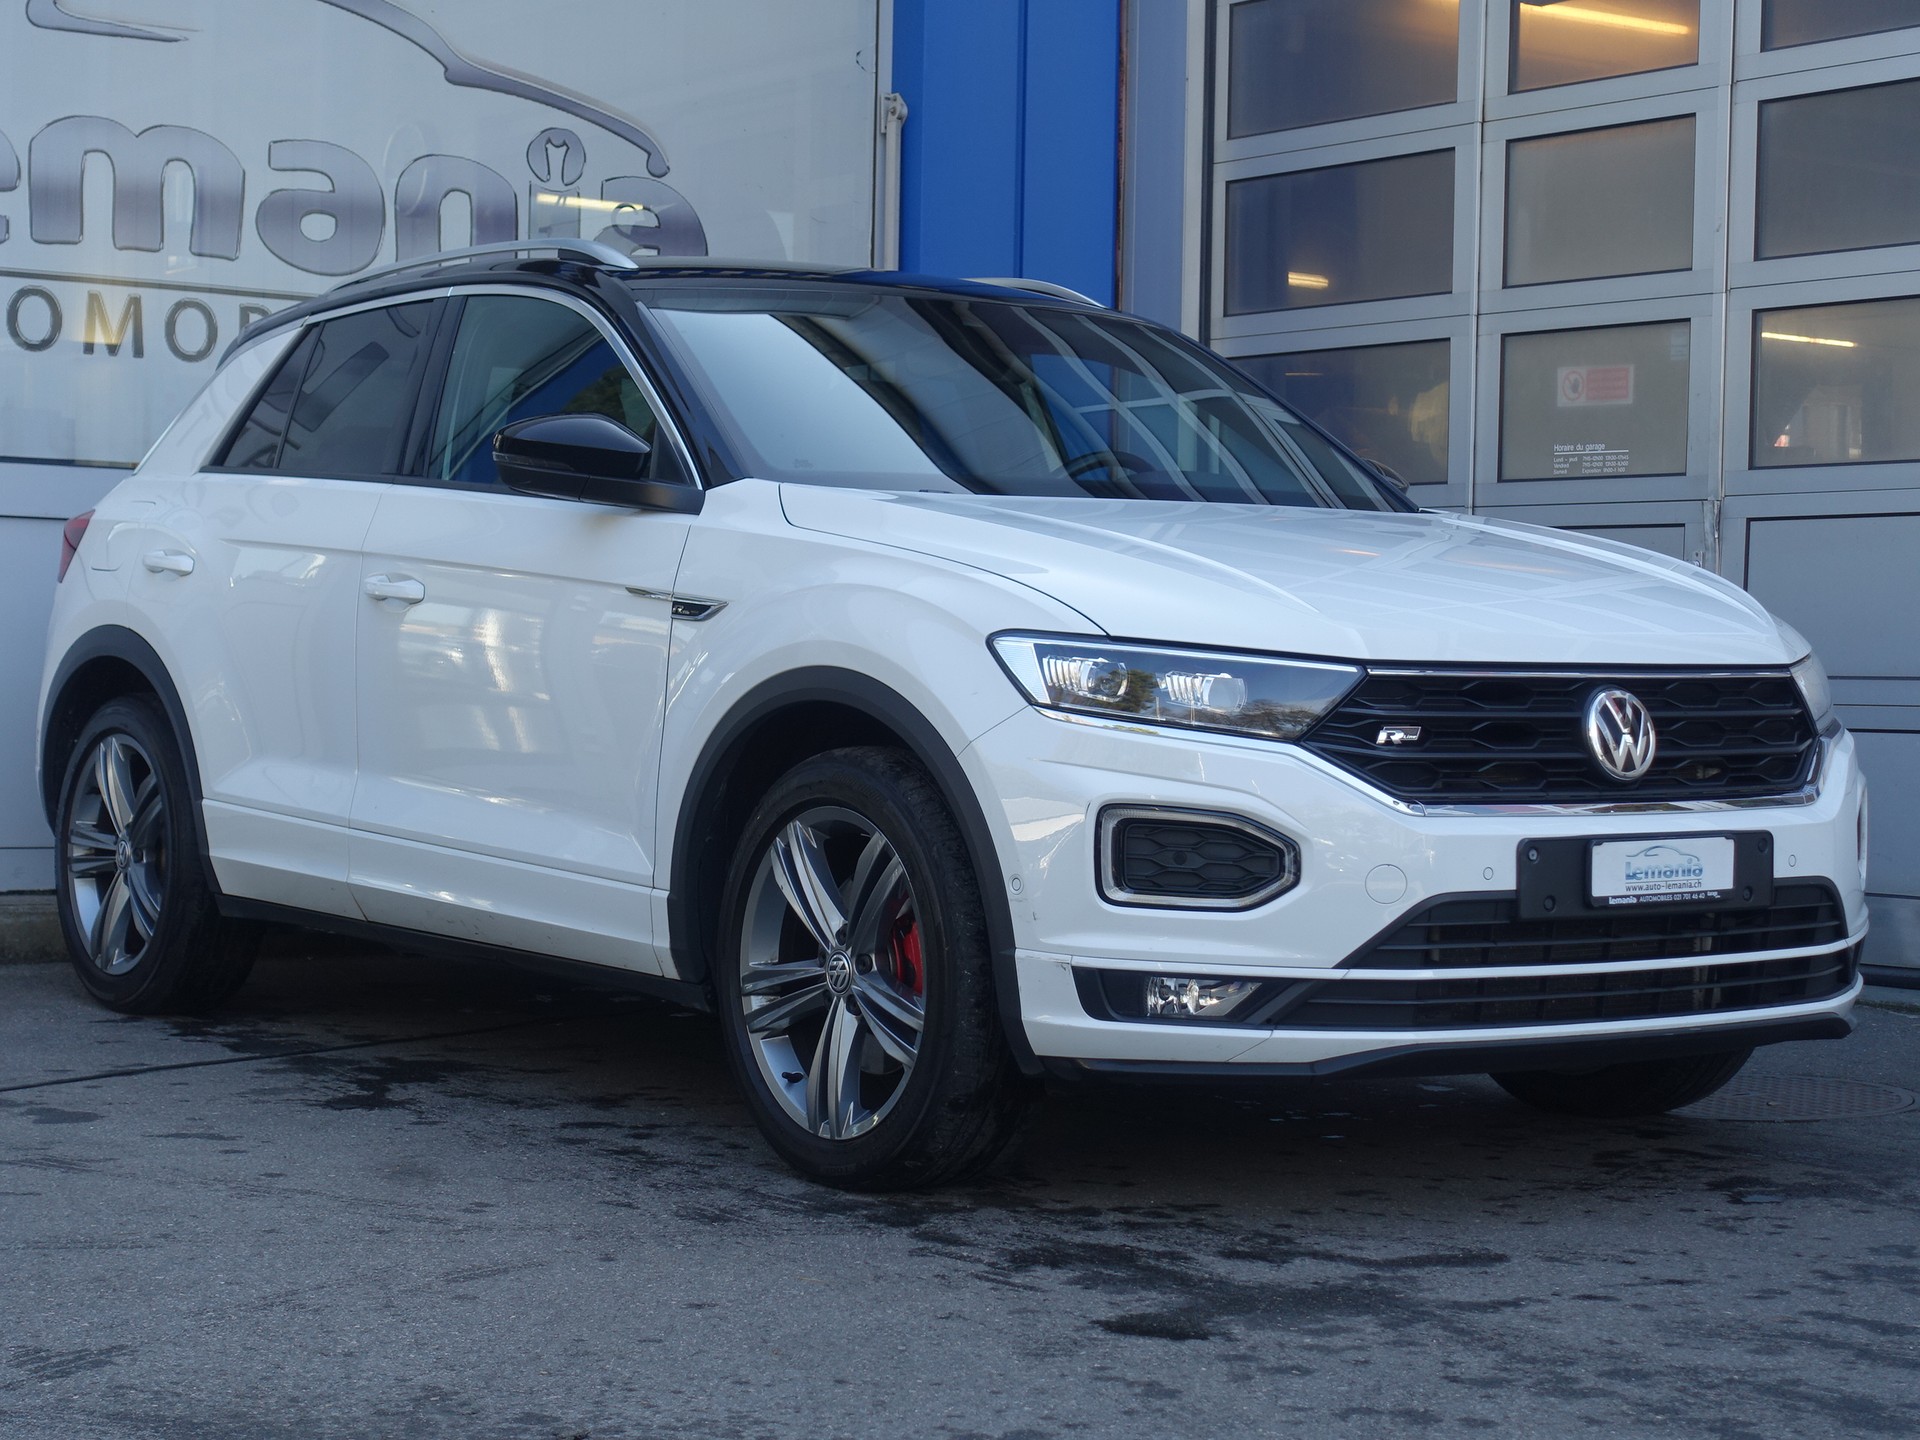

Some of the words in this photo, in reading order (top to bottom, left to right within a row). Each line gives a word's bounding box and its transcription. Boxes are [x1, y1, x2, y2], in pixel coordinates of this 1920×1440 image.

[0, 114, 708, 276] mania
[1553, 444, 1574, 452] Horaire
[1575, 443, 1584, 451] du
[1585, 443, 1606, 453] garage
[1625, 858, 1703, 881] Lemania
[1625, 879, 1702, 892] www.auto-lemania.ch
[1639, 893, 1673, 902] AUTOMOBILES
